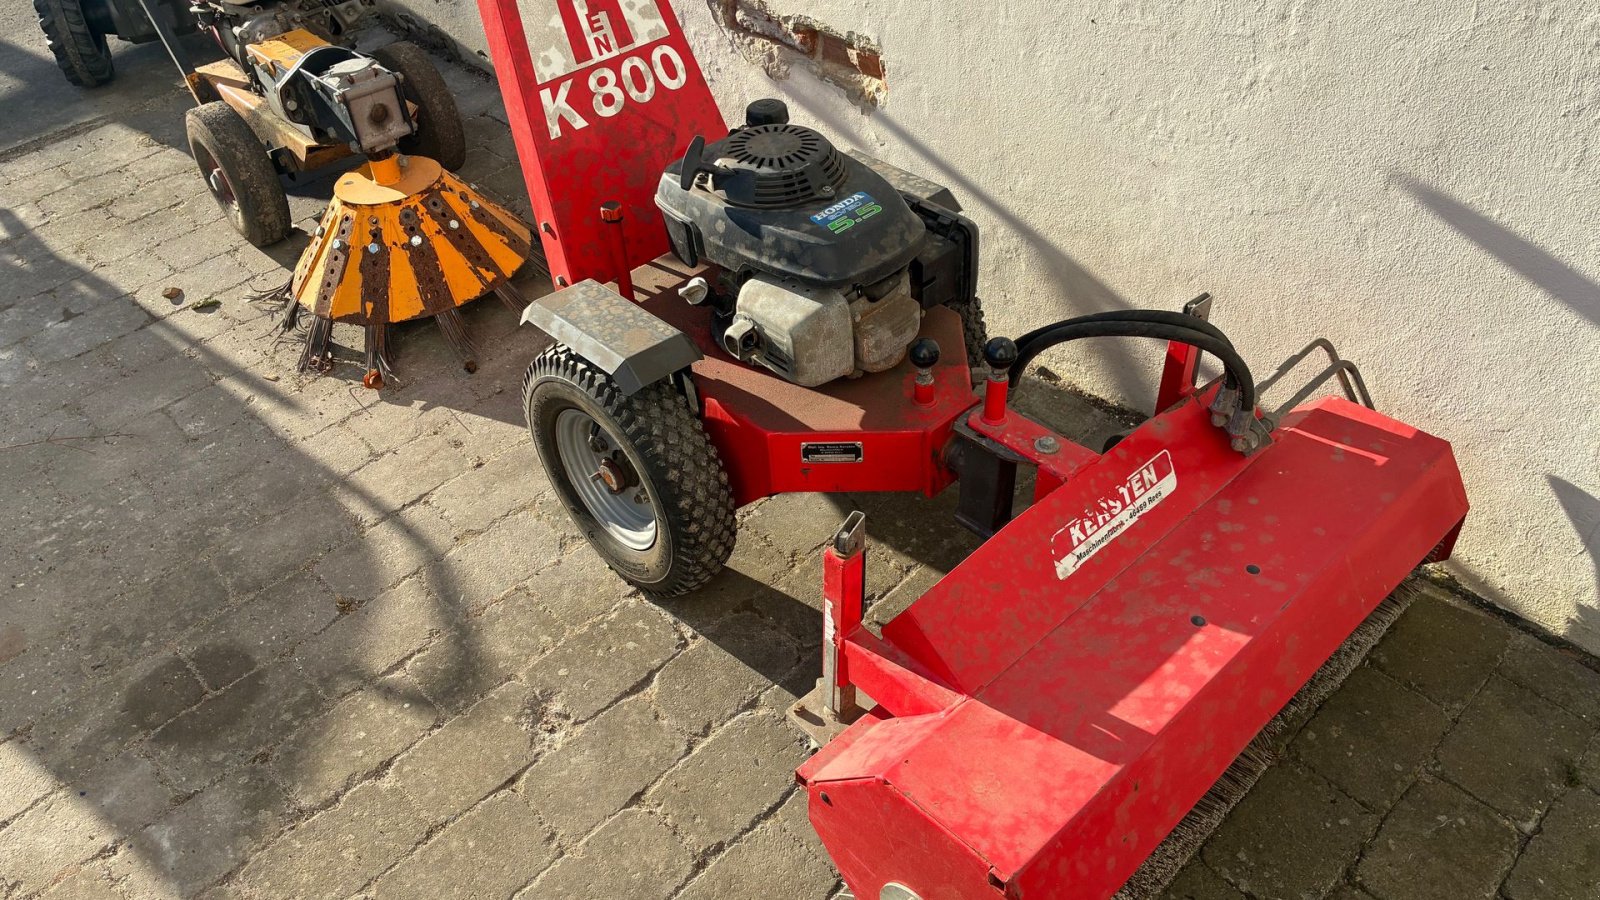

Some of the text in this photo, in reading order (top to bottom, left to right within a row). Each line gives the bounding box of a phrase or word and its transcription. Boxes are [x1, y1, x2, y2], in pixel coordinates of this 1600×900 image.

[539, 44, 688, 140] K 800
[815, 194, 865, 220] HONDA
[827, 202, 883, 235] 5.5
[1076, 520, 1126, 562] Maschinenfabrik
[1147, 490, 1162, 506] Rees
